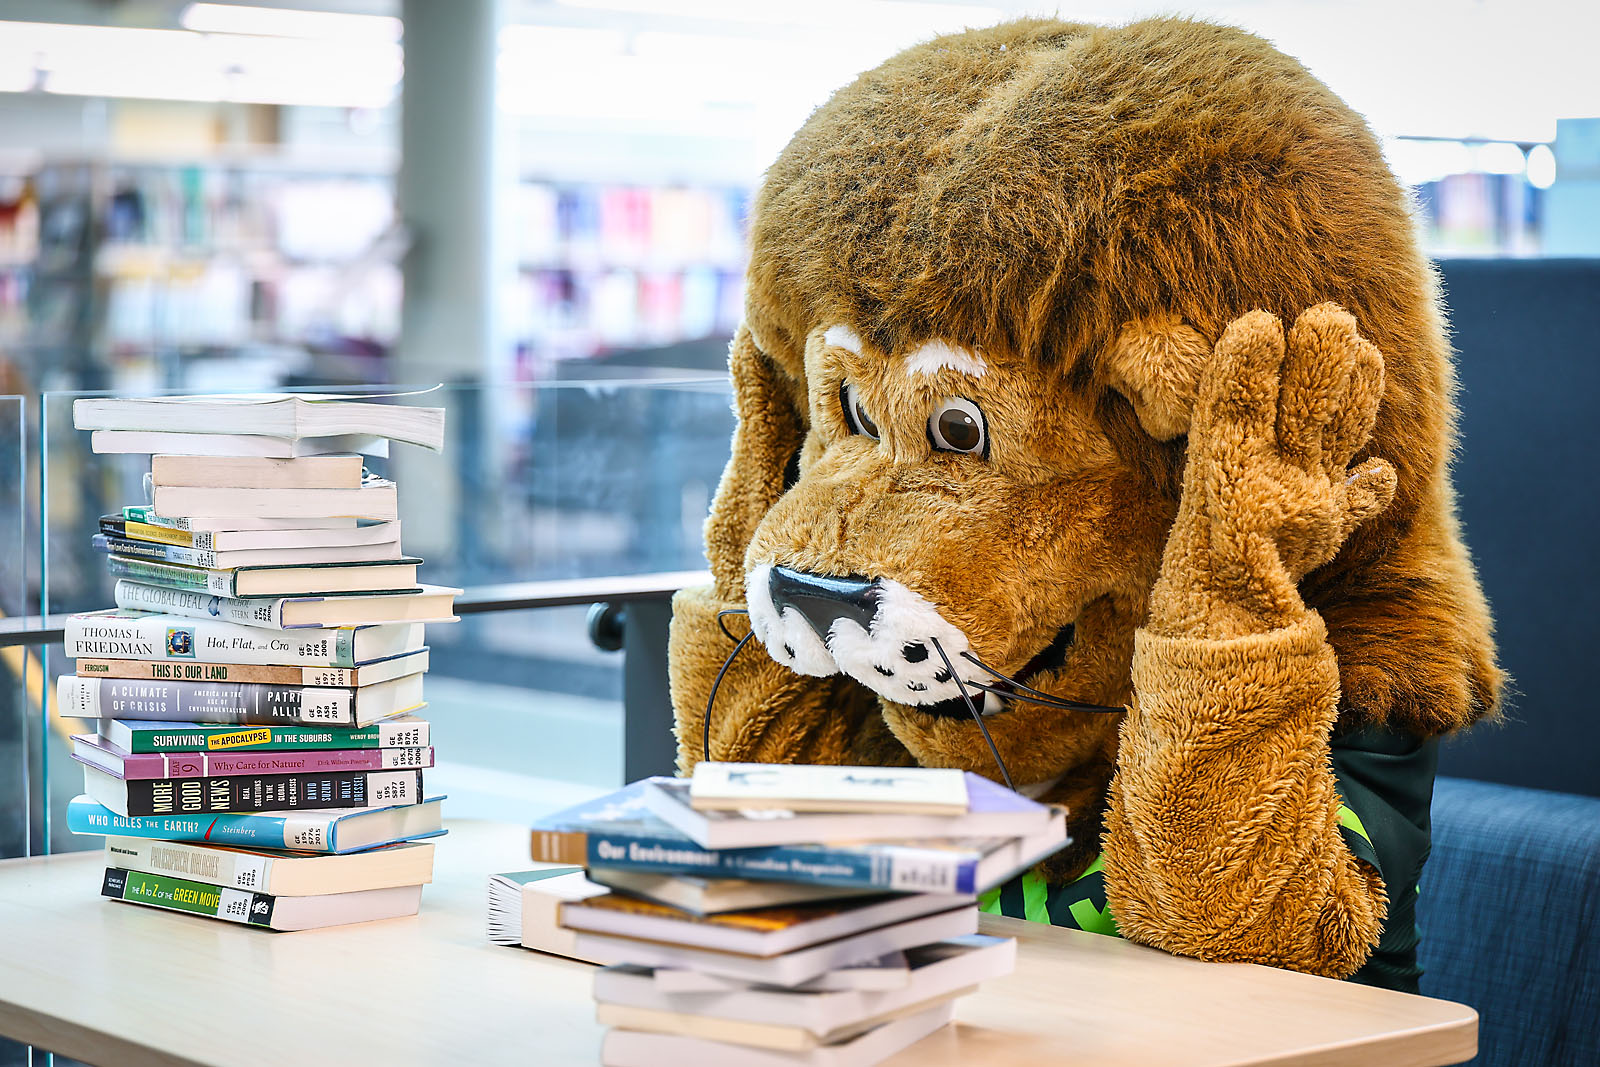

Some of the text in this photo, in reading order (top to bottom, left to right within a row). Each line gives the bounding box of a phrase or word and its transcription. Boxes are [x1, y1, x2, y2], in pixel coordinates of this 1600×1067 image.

[122, 585, 202, 610] THE GLOBAL DEAL
[231, 609, 249, 620] STERN
[254, 610, 258, 620] GE
[82, 627, 146, 640] THOMAS L.
[75, 640, 153, 655] FRIEDMAN
[207, 636, 228, 650] Hot,
[232, 638, 256, 651] Flat,
[299, 646, 304, 656] GE
[84, 664, 109, 672] FERGUSON
[152, 664, 228, 680] THIS IS OUR LAND
[315, 676, 320, 686] GE
[112, 686, 168, 698] A CLIMATE
[113, 700, 167, 712] OF CRISIS
[188, 705, 247, 714] ENVIRONMENTALISM
[309, 708, 314, 718] GE
[153, 734, 204, 746] SURVIVING
[221, 731, 268, 746] APOCALYPSE
[274, 734, 283, 743] IN
[284, 734, 298, 743] THE
[300, 734, 332, 743] SUBURBS
[390, 736, 396, 746] GE
[214, 762, 234, 772] Why
[236, 760, 256, 770] Care
[258, 760, 270, 770] for
[272, 759, 305, 769] Nature?
[392, 756, 398, 766] GE
[182, 764, 200, 773] 9
[210, 780, 230, 810] NEWS
[307, 782, 317, 800] DAVID
[322, 780, 332, 802] SUZUKI
[342, 780, 351, 800] HOLLY
[354, 776, 364, 802] DRESSEL
[376, 790, 382, 800] GE
[152, 782, 172, 813] MORE
[182, 781, 202, 812] GOOD
[88, 814, 256, 837] WHO RULES THE EARTH? Steinberg
[295, 836, 300, 844] GE
[598, 841, 625, 859] Our
[630, 842, 719, 866] Environment
[237, 875, 242, 885] GE
[132, 886, 140, 894] THE
[140, 882, 146, 896] A
[152, 884, 158, 897] Z
[158, 891, 164, 899] OF
[164, 892, 172, 900] THE
[174, 888, 198, 905] GREEN
[199, 892, 221, 908] MOVE
[227, 904, 232, 914] GE
